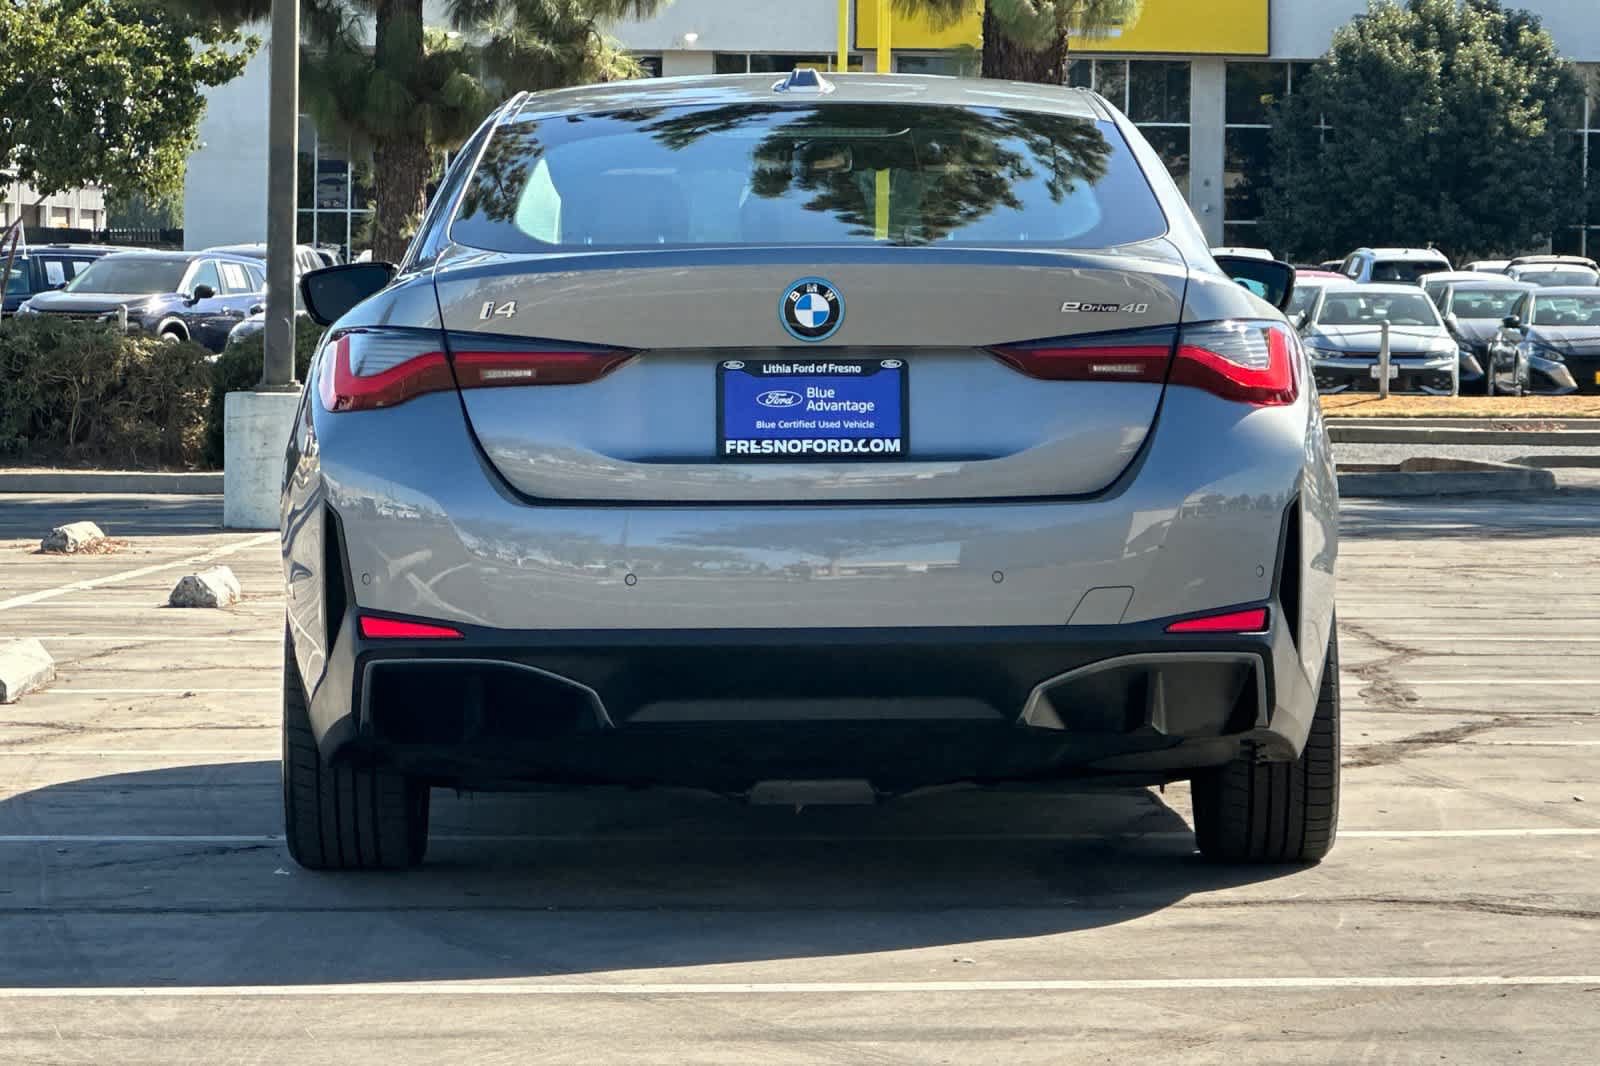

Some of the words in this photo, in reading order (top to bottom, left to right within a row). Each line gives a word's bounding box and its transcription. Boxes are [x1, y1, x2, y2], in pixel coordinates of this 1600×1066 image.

[789, 283, 836, 302] BMW
[480, 301, 516, 320] i4
[1121, 303, 1148, 313] 40
[763, 363, 791, 374] Lithia
[792, 363, 815, 374] Ford
[816, 363, 827, 374] of
[828, 363, 862, 374] Fresno
[806, 386, 835, 399] Blue
[806, 400, 875, 413] Advantage
[756, 420, 776, 429] Blue
[778, 420, 816, 429] Certified
[818, 420, 841, 429] Used
[843, 420, 875, 429] Vehicle
[725, 438, 901, 454] FRESNOFORD.COM
